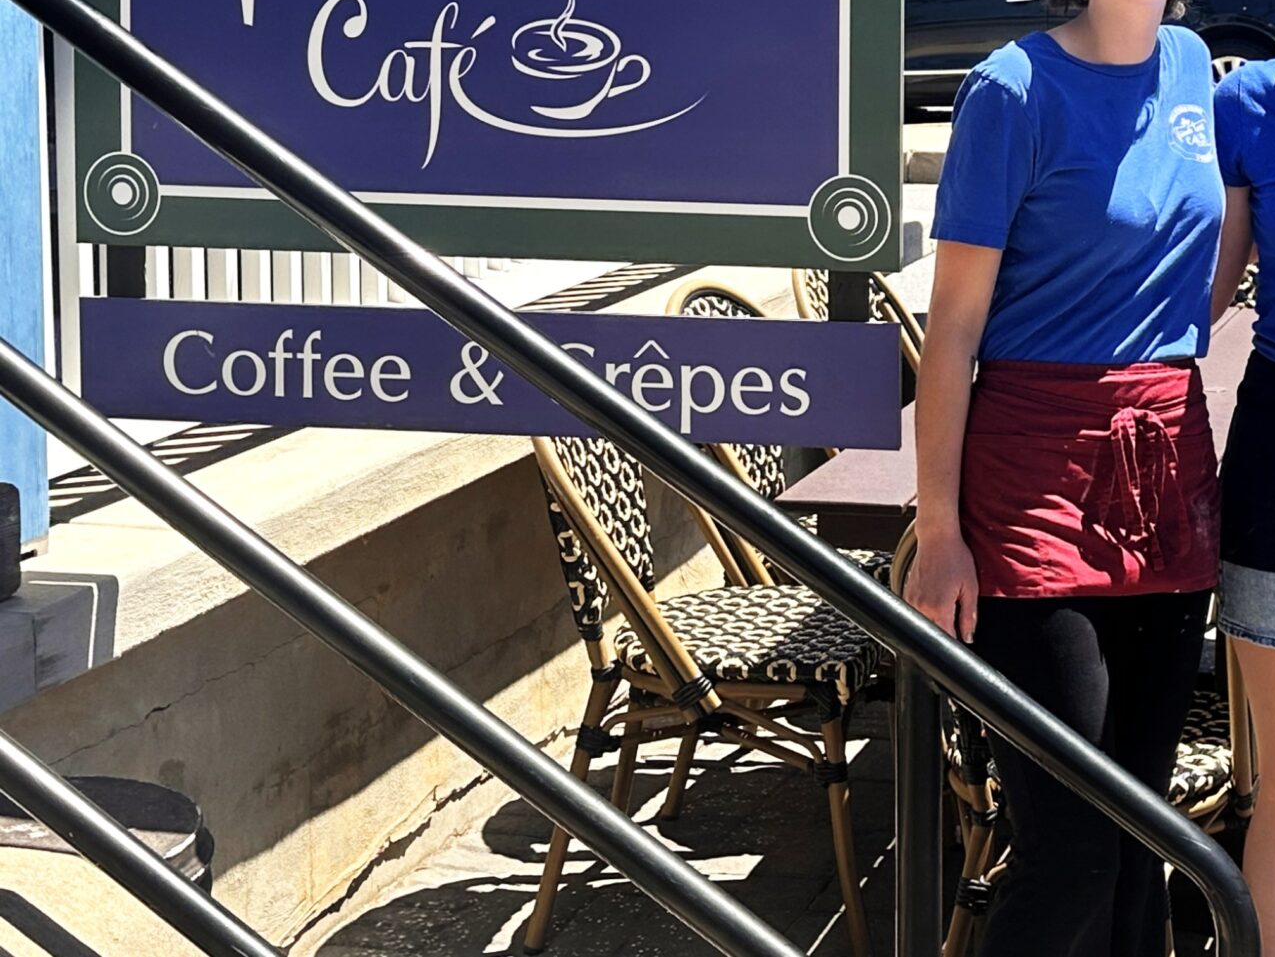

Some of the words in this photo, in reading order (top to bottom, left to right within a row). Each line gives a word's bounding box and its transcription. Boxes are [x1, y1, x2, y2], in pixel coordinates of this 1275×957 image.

[163, 330, 411, 403] Coffee
[450, 340, 504, 405] &
[553, 340, 812, 435] rêpes
